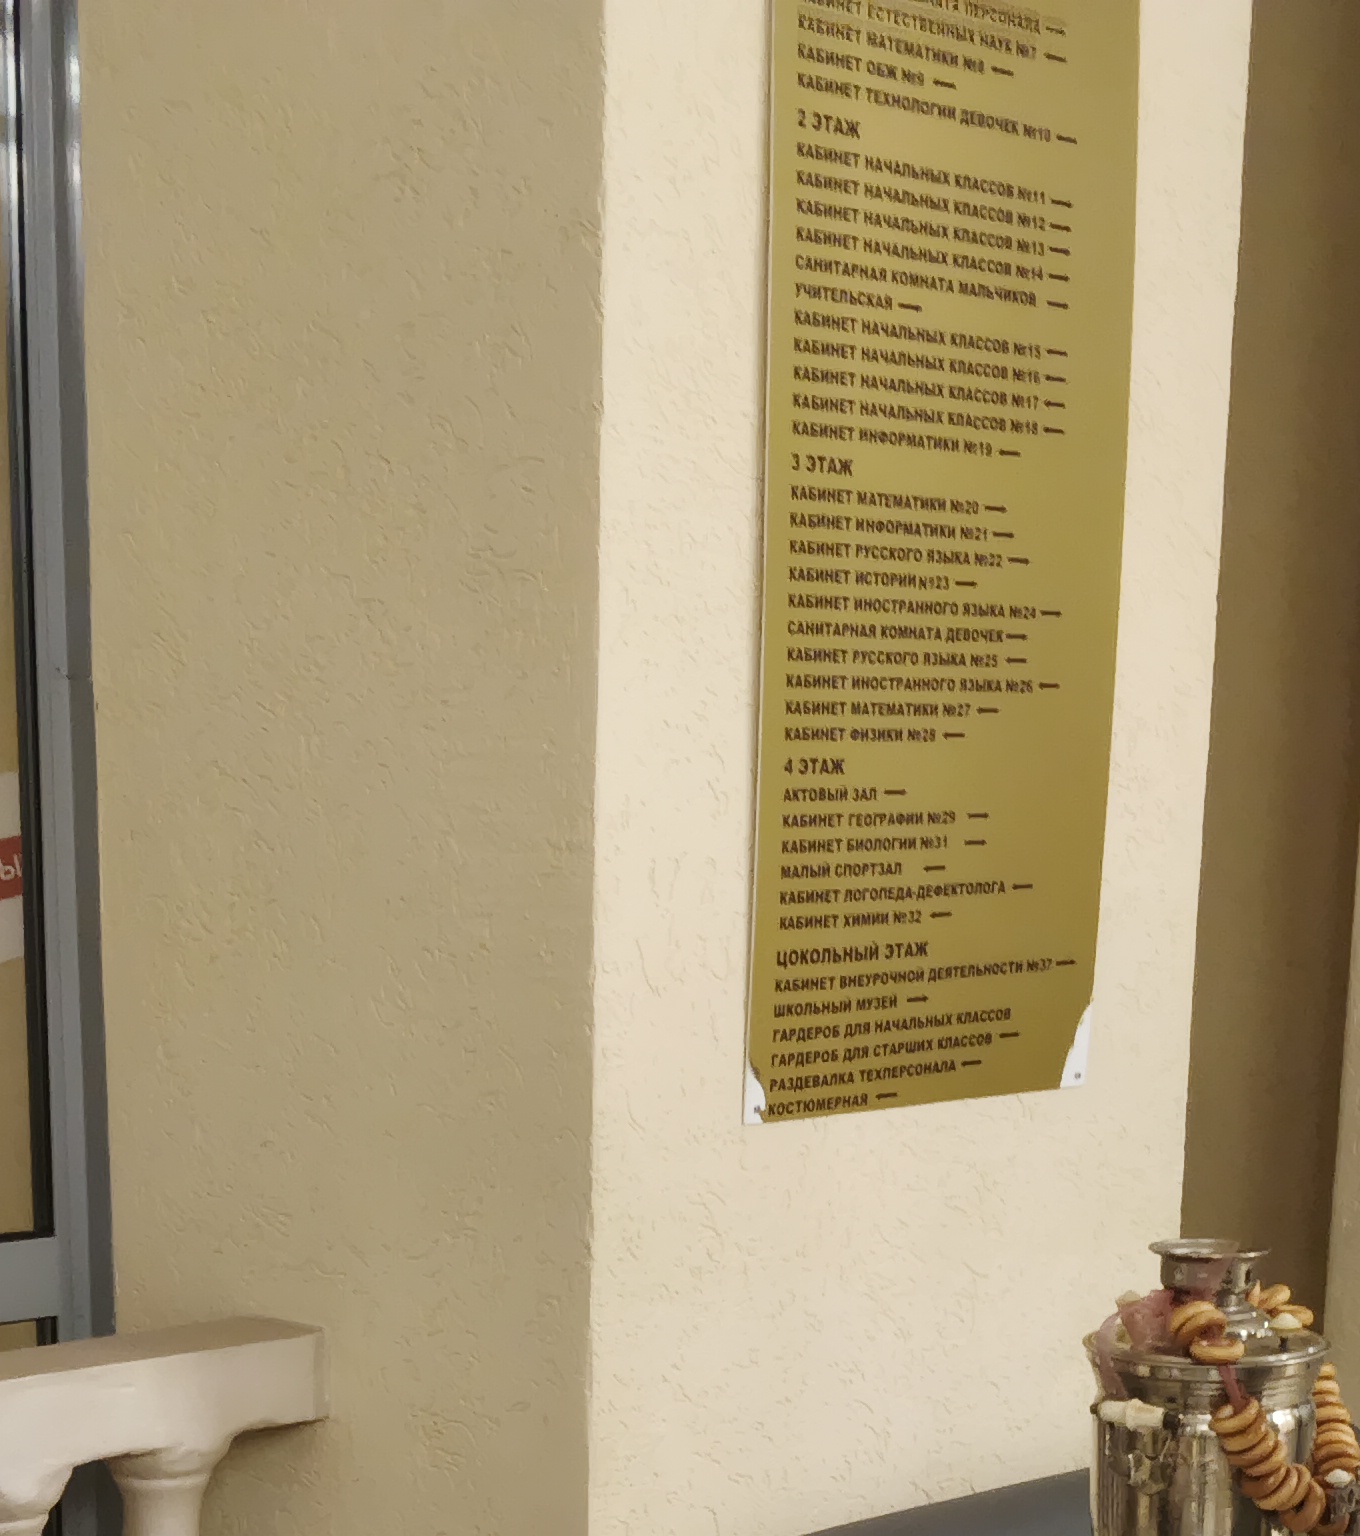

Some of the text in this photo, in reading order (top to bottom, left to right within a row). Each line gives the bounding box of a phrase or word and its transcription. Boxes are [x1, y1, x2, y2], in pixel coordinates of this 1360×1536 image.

[798, 43, 862, 72] КАБИНЕТ
[867, 60, 897, 80] ОБЖ
[797, 73, 861, 100] КАБИНЕТ
[866, 87, 956, 121] ТЕХНОЛОГИИ
[960, 109, 1018, 136] ДЕВОЧЕК
[797, 108, 861, 140] 2 ЭТАЖ
[797, 142, 1045, 204] КАБИНЕТ НАЧАЛЬНЫХ КЛАССОВ №11
[796, 170, 860, 195] КАБИНЕТ
[864, 183, 949, 214] НАЧАЛЬНЫХ
[954, 200, 1013, 225] КЛАССОВ
[796, 198, 859, 223] КАБИНЕТ
[864, 210, 949, 240] НАЧАЛЬНЫХ
[953, 227, 1013, 250] КЛАССОВ
[796, 227, 859, 250] КАБИНЕТ
[863, 237, 948, 266] НАЧАЛЬНЫХ
[953, 254, 1012, 276] КЛАССОВ
[795, 255, 1037, 307] САНИТАРНАЯ КОМНАТА МАЛЬЧИКОВ
[795, 283, 893, 310] УЧИТЕЛЬСКАЯ
[795, 309, 1041, 359] КАБИНЕТ НАЧАЛЬНЫХ КЛАССОВ №15
[794, 337, 1040, 384] КАБИНЕТ НАЧАЛЬНЫХ КЛАССОВ №16
[794, 366, 1039, 410] КАБИНЕТ НАЧАЛЬНЫХ КЛАССОВ №17
[793, 393, 854, 414] КАБИНЕТ
[860, 400, 943, 425] НАЧАЛЬНЫХ
[948, 412, 1006, 432] КЛАССОВ
[792, 420, 854, 441] КАБИНЕТ
[859, 427, 959, 452] ИНФОРМАТИКИ
[792, 453, 853, 476] 3 ЭТАЖ
[791, 484, 979, 515] КАБИНЕТ МАТЕМАТИКИ №20
[790, 512, 851, 531] КАБИНЕТ
[856, 517, 955, 540] ИНФОРМАТИКИ
[789, 540, 1003, 568] КАБИНЕТ РУССКОГО ЯЗЫКА №22
[789, 566, 850, 585] КАБИНЕТ
[855, 570, 917, 588] ИСТОРИИ
[788, 593, 849, 611] КАБИНЕТ
[853, 597, 958, 616] ИНОСТРАННОГО
[963, 603, 1005, 617] ЯЗЫКА
[787, 620, 1004, 644] САНИТАРНАЯ КОМНАТА ДЕВОЧЕК
[787, 647, 848, 664] КАБИНЕТ
[853, 649, 918, 666] РУССКОГО
[923, 652, 966, 666] ЯЗЫКА
[786, 673, 847, 690] КАБИНЕТ
[852, 676, 955, 692] ИНОСТРАННОГО
[960, 678, 1003, 693] ЯЗЫКА
[785, 701, 971, 717] КАБИНЕТ МАТЕМАТИКИ №27
[785, 727, 846, 742] КАБИНЕТ
[850, 727, 903, 742] ФИЗИКИ
[784, 757, 845, 775] 4 ЭТАЖ
[784, 785, 877, 802] АКТОВЫЙ ЗАЛ
[783, 813, 844, 828] КАБИНЕТ
[848, 812, 924, 828] ГЕОГРАФИИ
[782, 838, 843, 854] КАБИНЕТ
[847, 837, 917, 853] БИОЛОГИИ
[781, 862, 902, 879] МАЛЫЙ СПОРТЗАЛ
[780, 881, 1006, 905] КАБИНЕТ ЛОГОПЕДА-ДЕФЕКТОЛОГА
[779, 910, 922, 930] КАБИНЕТ ХИМИИ №32
[776, 941, 929, 970] ЦОКОЛЬНЫЙ ЭТАЖ
[775, 976, 835, 992] КАБИНЕТ
[840, 968, 924, 989] ВНЕУРОЧНОЙ
[928, 961, 1023, 983] ДЕЯТЕЛЬНОСТИ
[774, 995, 898, 1018] ШКОЛЬНЫЙ МУЗЕЙ
[773, 1008, 1012, 1043] ГАРДЕРОБ ДЛЯ НАЧАЛЬНЫХ КЛАССОВ
[771, 1033, 993, 1068] ГАРДЕРОБ ДЛЯ СТАРШИХ КЛАССОВ
[770, 1060, 956, 1092] РАЗДЕВАЛКА ТЕХПЕРСОНАЛА
[768, 1093, 868, 1116] КОСТЮМЕРНАЯ
